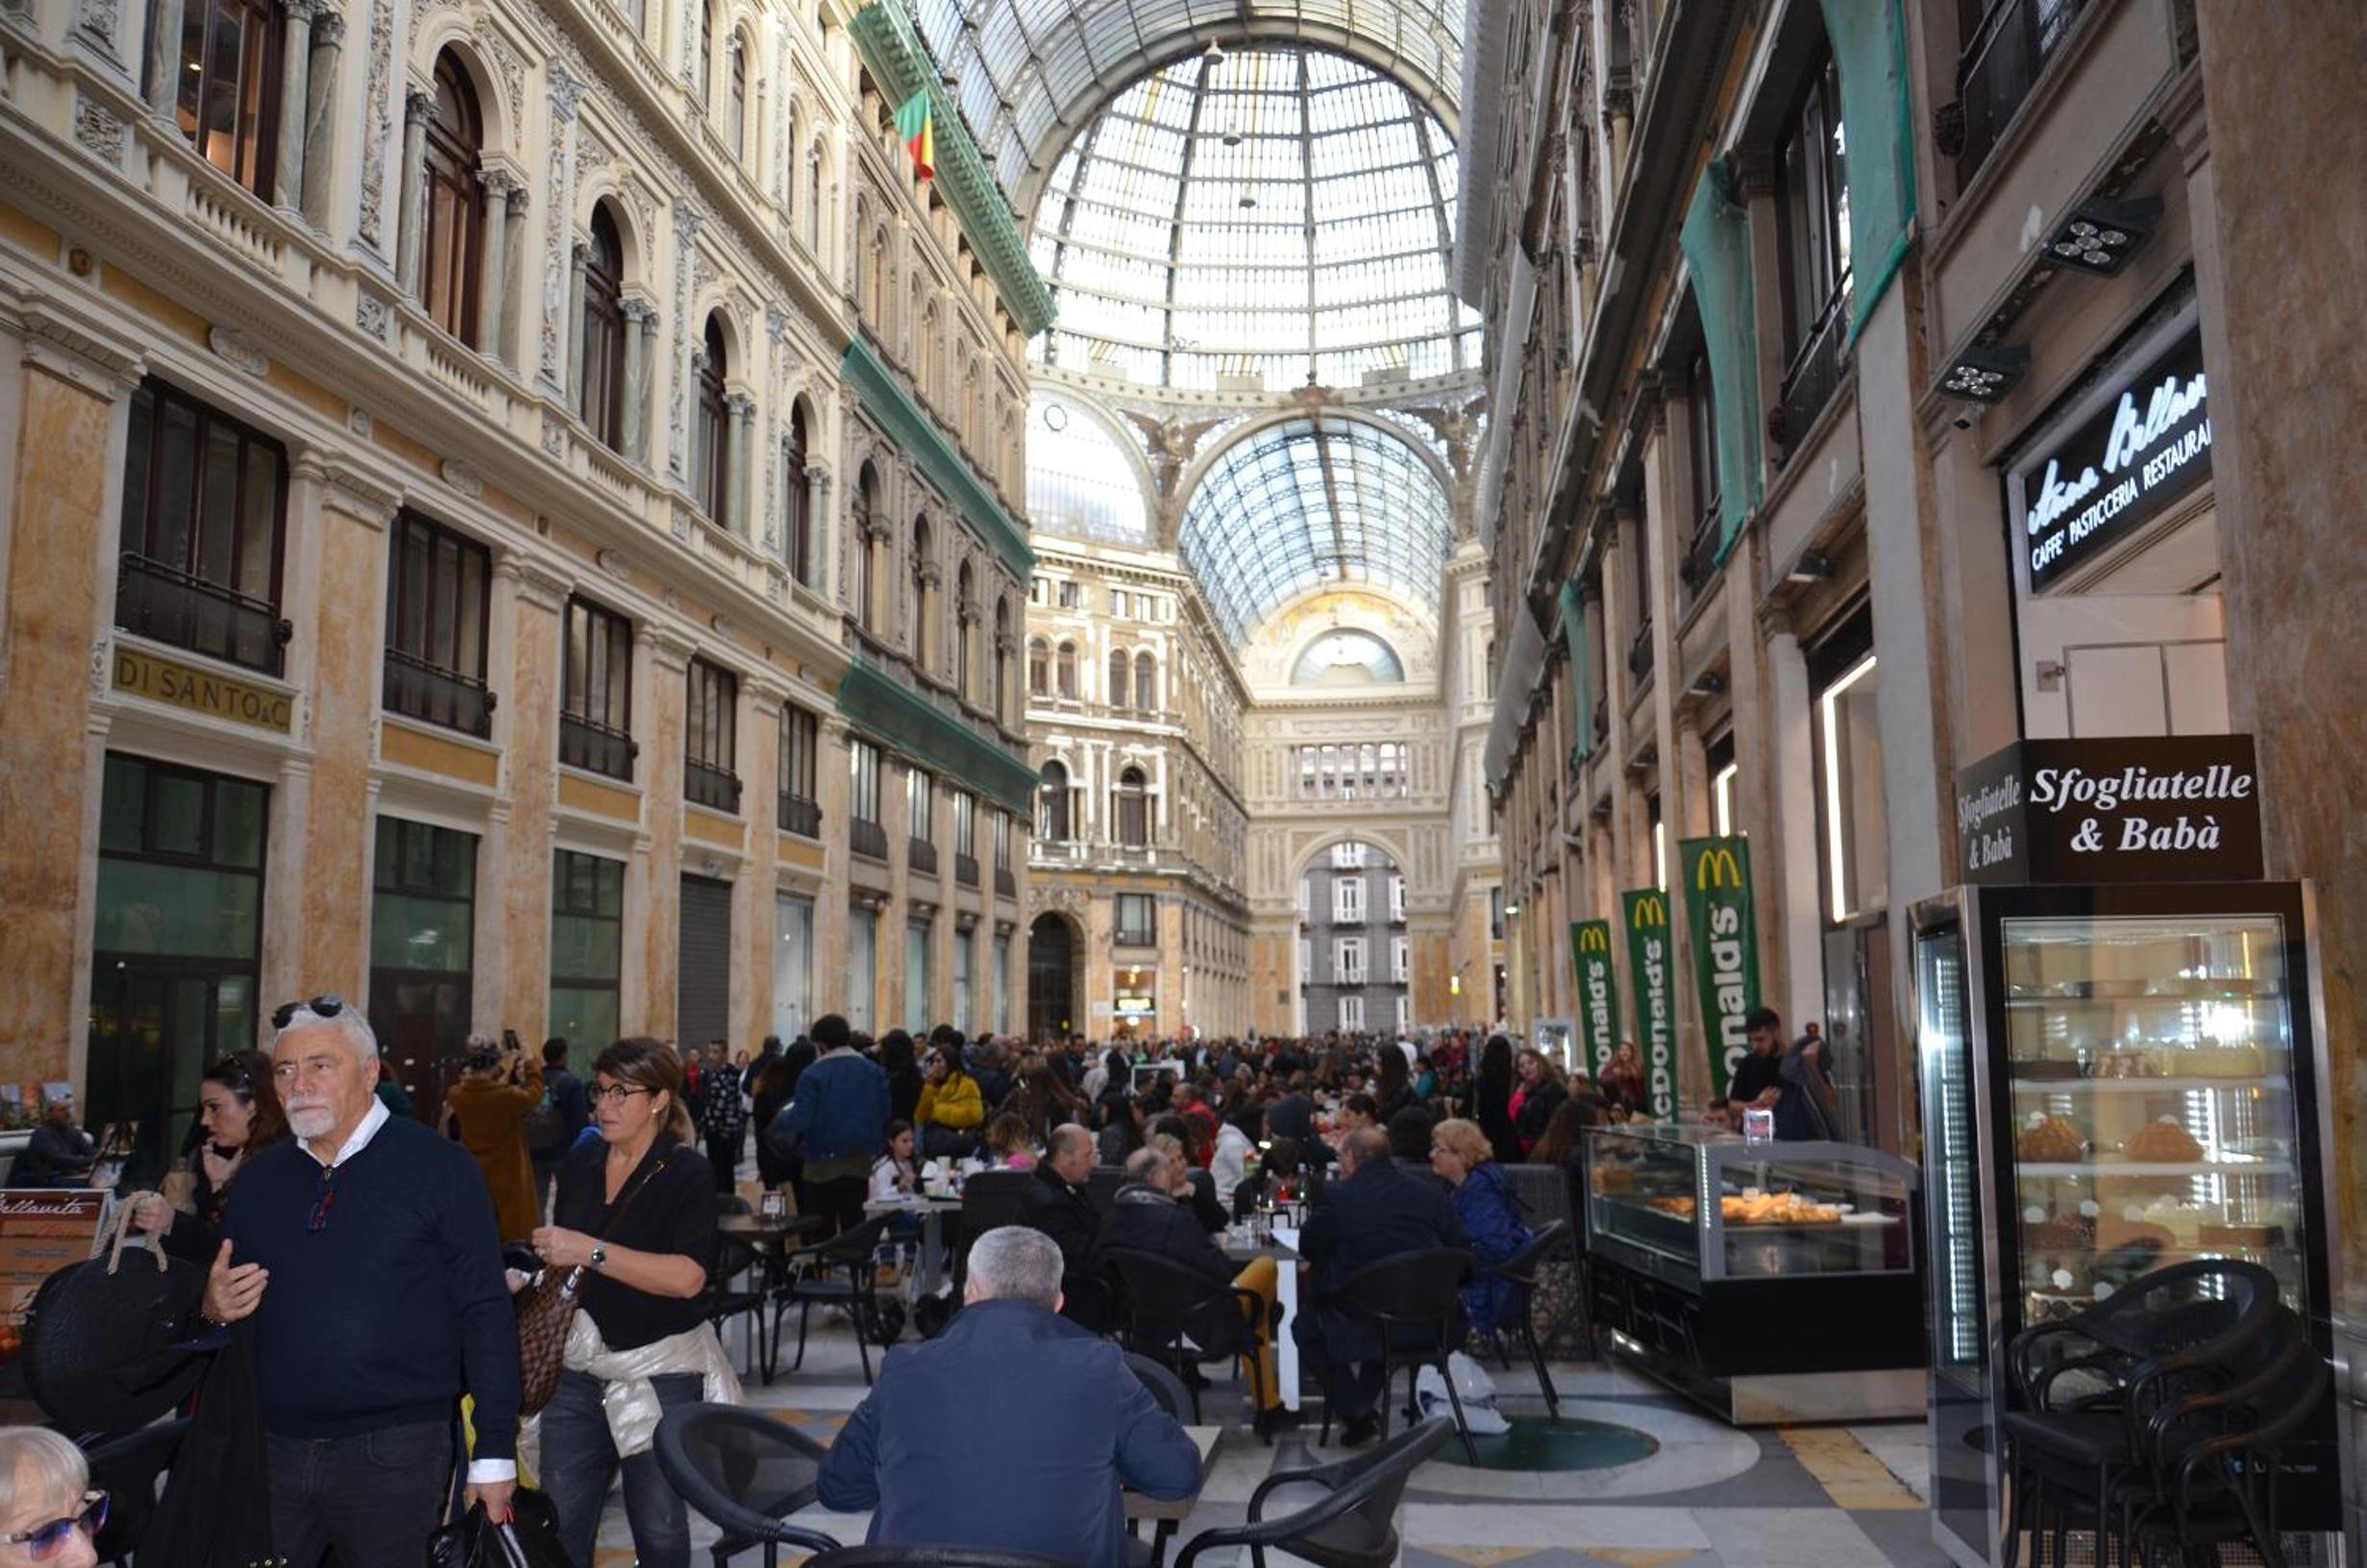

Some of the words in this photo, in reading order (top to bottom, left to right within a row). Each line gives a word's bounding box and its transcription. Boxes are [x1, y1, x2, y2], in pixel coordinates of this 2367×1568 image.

[2069, 477, 2138, 545] PASTICCERIA
[119, 657, 150, 691] DI
[1959, 774, 2020, 834] Sfogliatelle
[2030, 765, 2252, 812] Sfogliatelle
[1982, 827, 2011, 866] Babà
[2070, 818, 2104, 852] &
[2117, 816, 2220, 851] Babà
[1711, 906, 1749, 1097] onald's
[1644, 939, 1672, 1123] cDonald's
